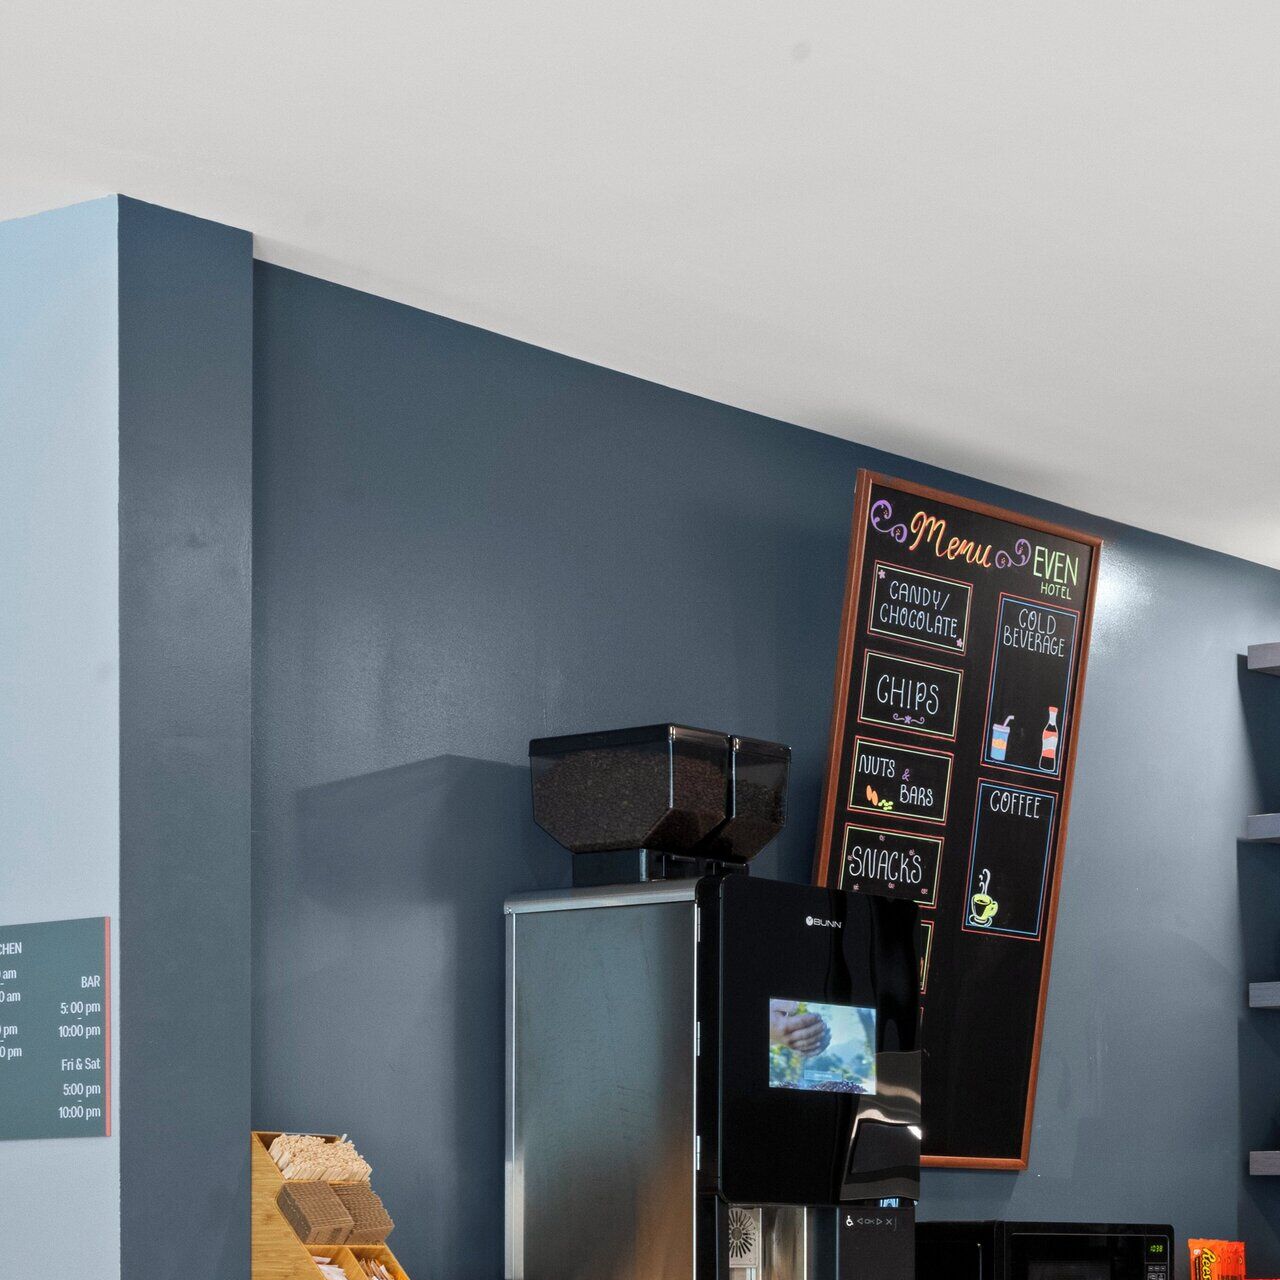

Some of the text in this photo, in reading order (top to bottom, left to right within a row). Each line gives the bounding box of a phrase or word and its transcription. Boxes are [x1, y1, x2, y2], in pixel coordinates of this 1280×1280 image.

[909, 511, 992, 568] Menu
[1033, 545, 1078, 586] EVEN
[889, 580, 950, 610] CANDY/
[1040, 581, 1072, 600] HOTEL
[879, 604, 958, 639] CHOCOLATE
[1018, 607, 1057, 635] COLD
[1003, 625, 1065, 658] BEVERAGE
[876, 674, 939, 715] CHIPS
[858, 754, 910, 782] NUTS &
[900, 784, 934, 807] BARS
[990, 790, 1042, 819] COFFEE
[849, 846, 922, 884] SNACKS
[813, 917, 842, 928] BUNN
[2, 969, 17, 980] am
[81, 975, 101, 988] BAR
[6, 991, 21, 1002] am
[86, 1003, 101, 1016] pm
[3, 1025, 18, 1037] pm
[58, 1025, 101, 1039] 10:00 pm
[7, 1047, 23, 1060] pm
[61, 1057, 101, 1071] Fri & Sat
[63, 1083, 101, 1098] 5:00 pm
[58, 1105, 101, 1120] 10:00 pm
